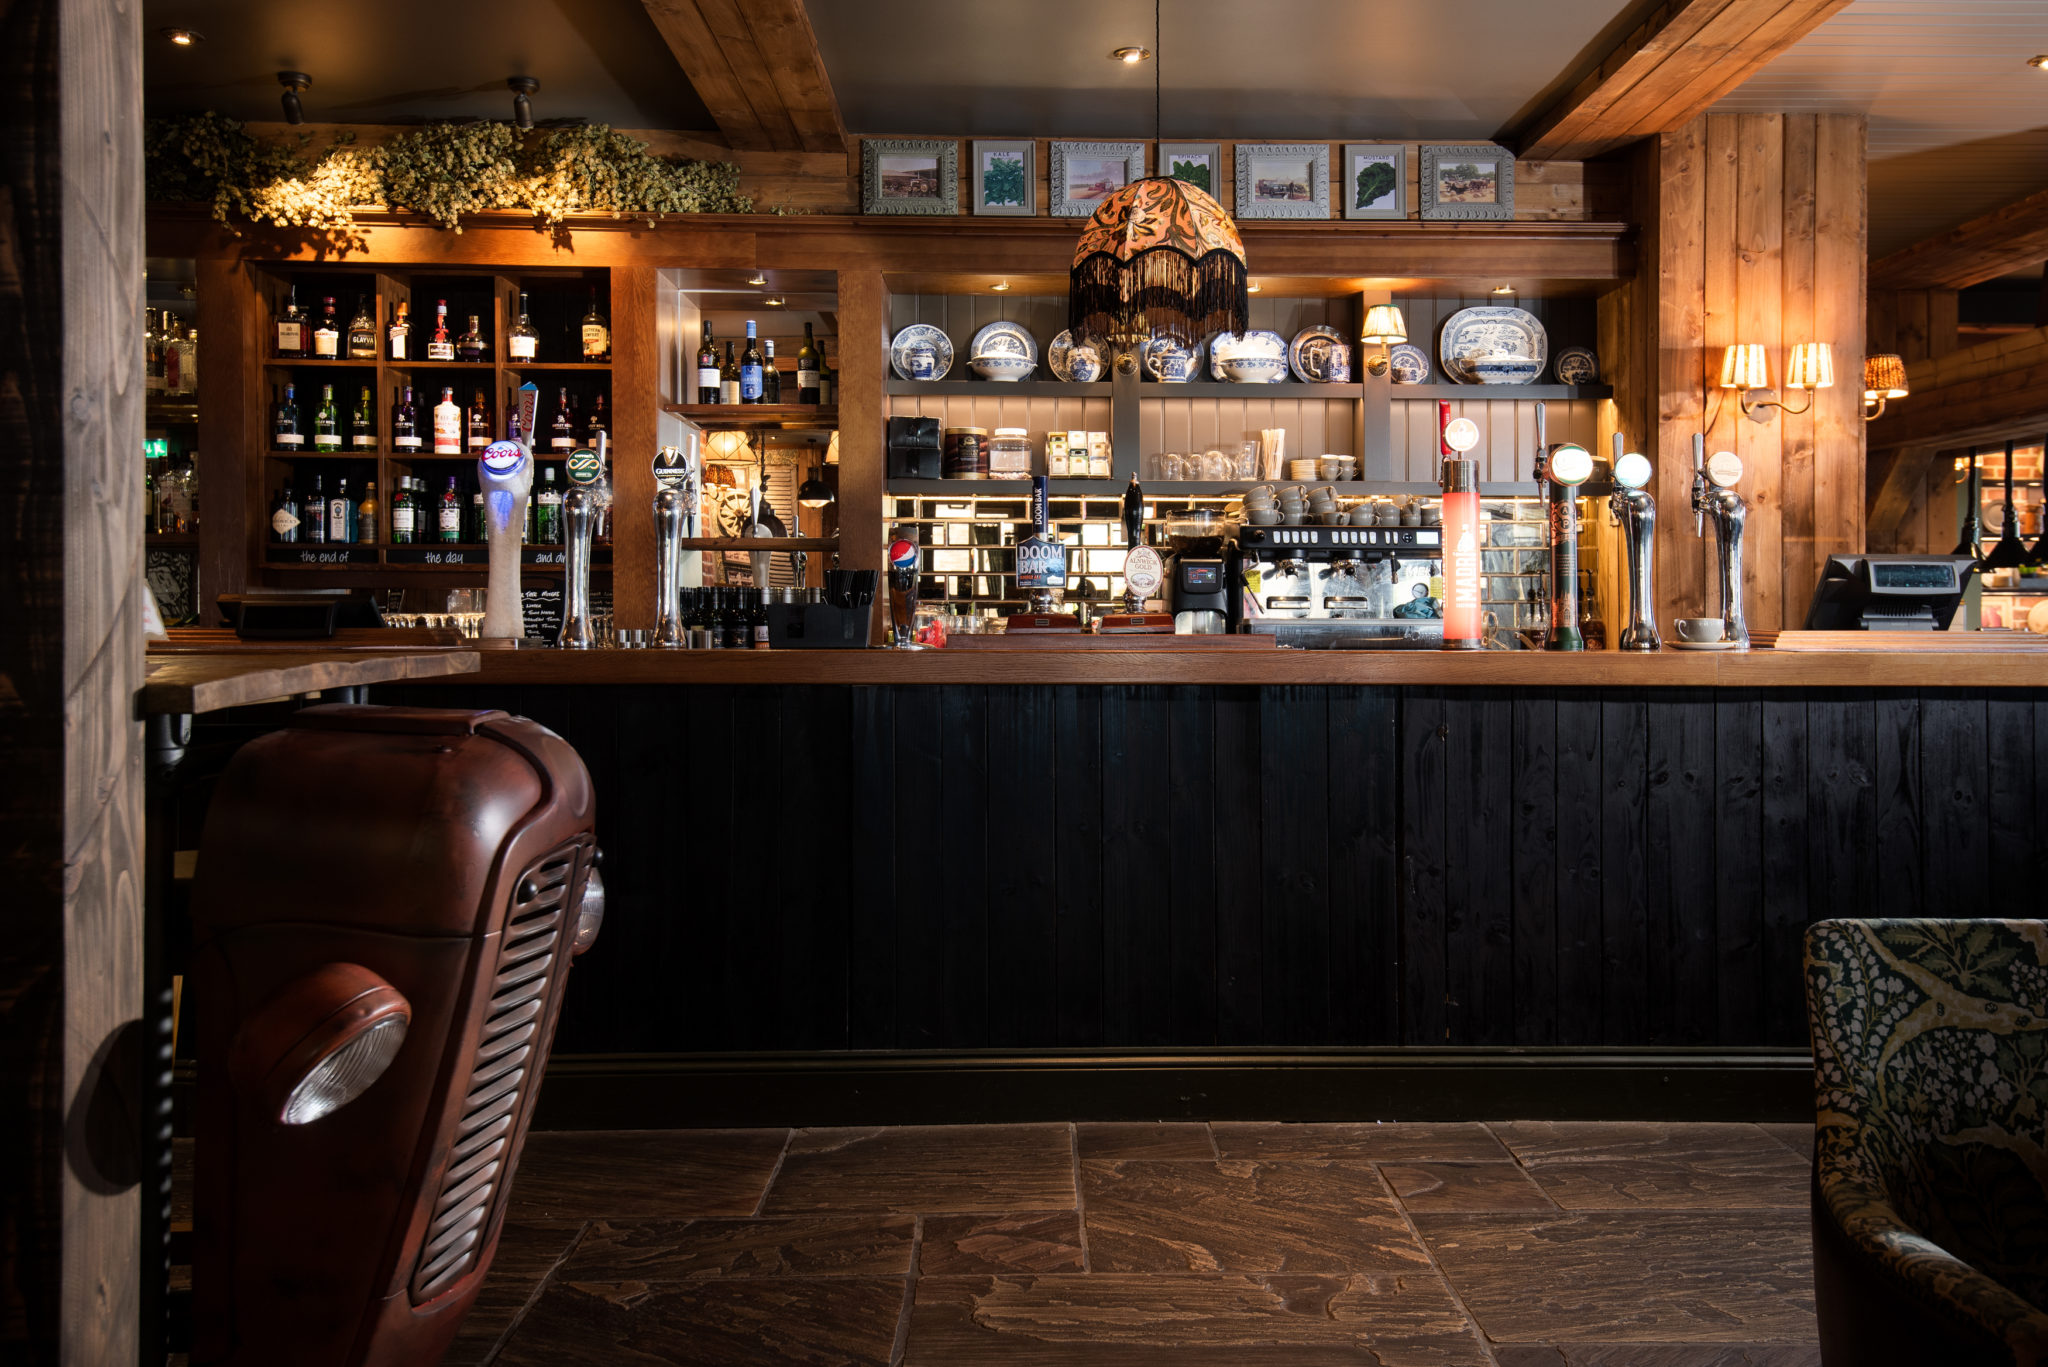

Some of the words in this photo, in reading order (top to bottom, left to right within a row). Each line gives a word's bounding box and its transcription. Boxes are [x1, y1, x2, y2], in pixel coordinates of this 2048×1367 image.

[352, 336, 374, 344] GLAYVA
[520, 393, 535, 432] Coors
[482, 447, 522, 461] Coors
[1035, 488, 1043, 502] BAR
[1035, 503, 1043, 525] DOOM
[300, 550, 317, 563] the
[319, 550, 337, 563] end
[338, 550, 350, 563] of
[425, 551, 442, 563] the
[445, 551, 464, 565] day
[535, 551, 553, 563] and
[1019, 545, 1063, 560] DOOM
[1019, 560, 1049, 574] BAR
[1129, 557, 1158, 566] ALNWICK
